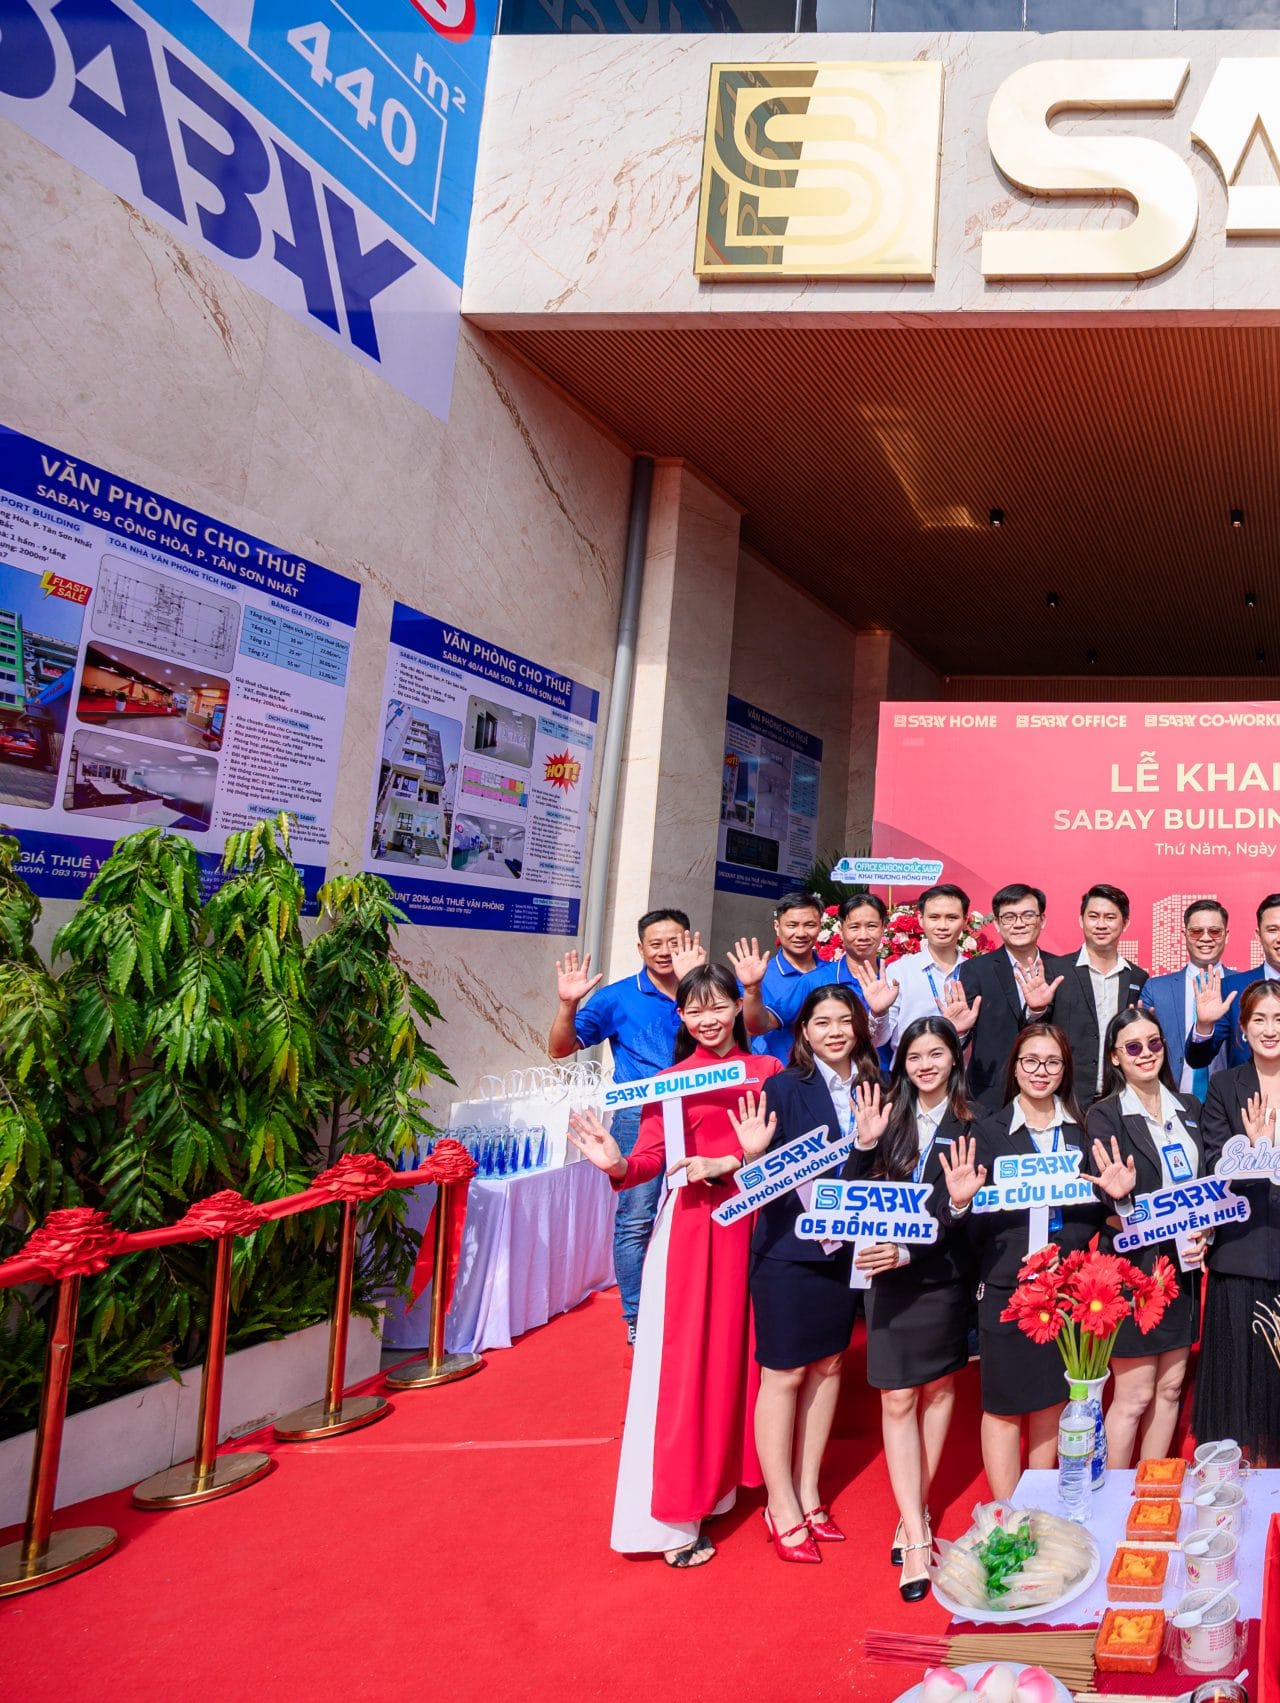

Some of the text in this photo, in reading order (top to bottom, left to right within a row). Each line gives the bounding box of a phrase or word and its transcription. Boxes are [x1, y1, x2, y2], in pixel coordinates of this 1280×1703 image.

[287, 21, 416, 166] 440
[41, 455, 307, 583] VĂN PHÒNG CHO THUÊ
[37, 484, 298, 598] SABAY 99 CỘNG HÒA, P. TÂN SƠN NHẤT
[53, 577, 88, 602] FLASH SALE
[443, 630, 572, 695] VĂN PHÒNG CHO THUÊ
[443, 650, 499, 680] SABAY 40/4 LAM
[908, 715, 997, 728] SABAY HOME
[1030, 714, 1127, 728] SABAY OFFICE
[1158, 714, 1197, 727] SABAY
[546, 763, 579, 782] HOT!
[1111, 750, 1160, 793] LỄ
[1176, 762, 1280, 793] KHAI
[1053, 808, 1156, 831] SABAY
[1154, 841, 1186, 856] Thứ
[1189, 842, 1232, 857] Năm,
[1236, 841, 1276, 859] Ngày
[855, 862, 877, 872] OFFICE
[605, 1066, 741, 1105] SABAY BUILDING
[764, 1130, 830, 1175] SABAY
[1021, 1155, 1078, 1176] SABAY
[718, 1153, 836, 1222] VĂN PHÒNG KHÔNG
[845, 1186, 929, 1214] SABAY
[974, 1182, 1091, 1206] 05 CỬU LON
[1153, 1180, 1228, 1218] SABAY
[800, 1211, 933, 1239] 05 ĐỒNG NAI
[1118, 1200, 1247, 1249] 68 NGUYỄN HUỆ
